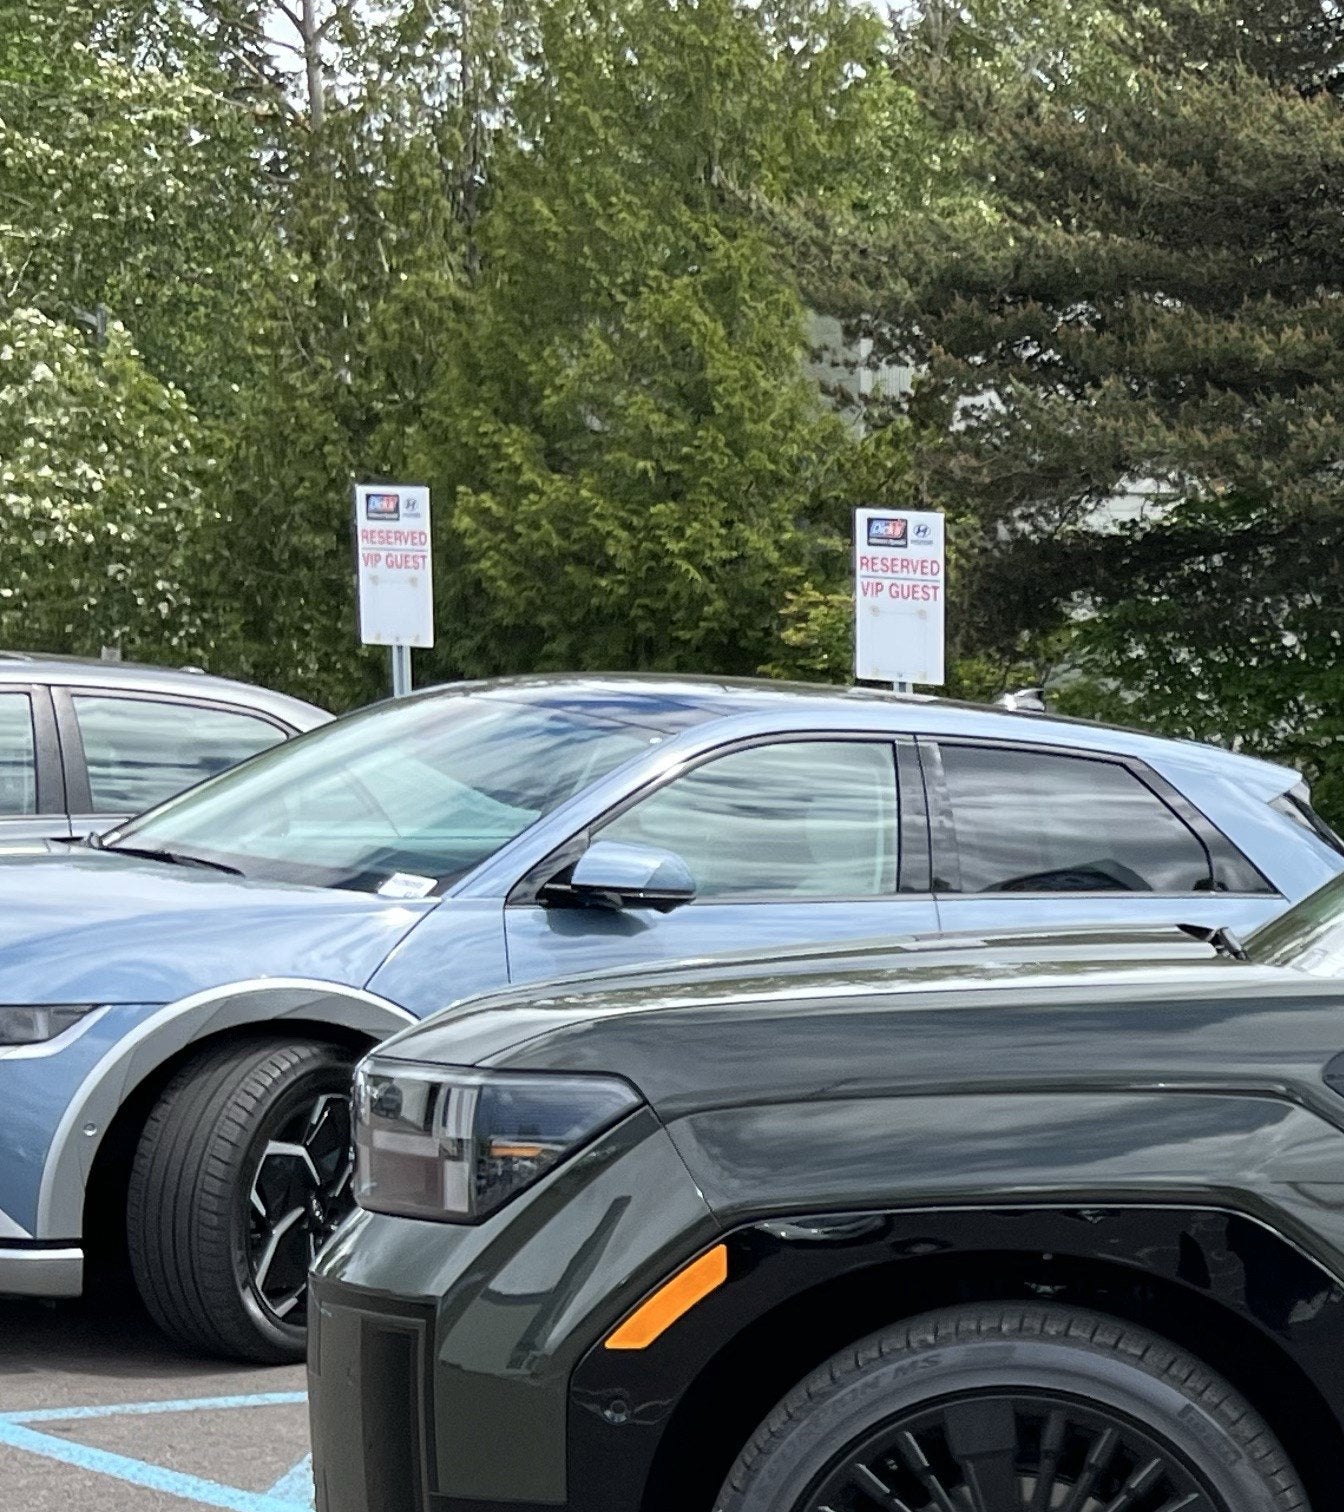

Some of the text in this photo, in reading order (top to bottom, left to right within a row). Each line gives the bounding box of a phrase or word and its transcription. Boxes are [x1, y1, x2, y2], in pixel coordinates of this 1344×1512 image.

[361, 528, 428, 547] RESERVED
[362, 552, 428, 570] VIP GUEST
[859, 555, 941, 577] RESERVED
[861, 581, 941, 602] VIP GUEST
